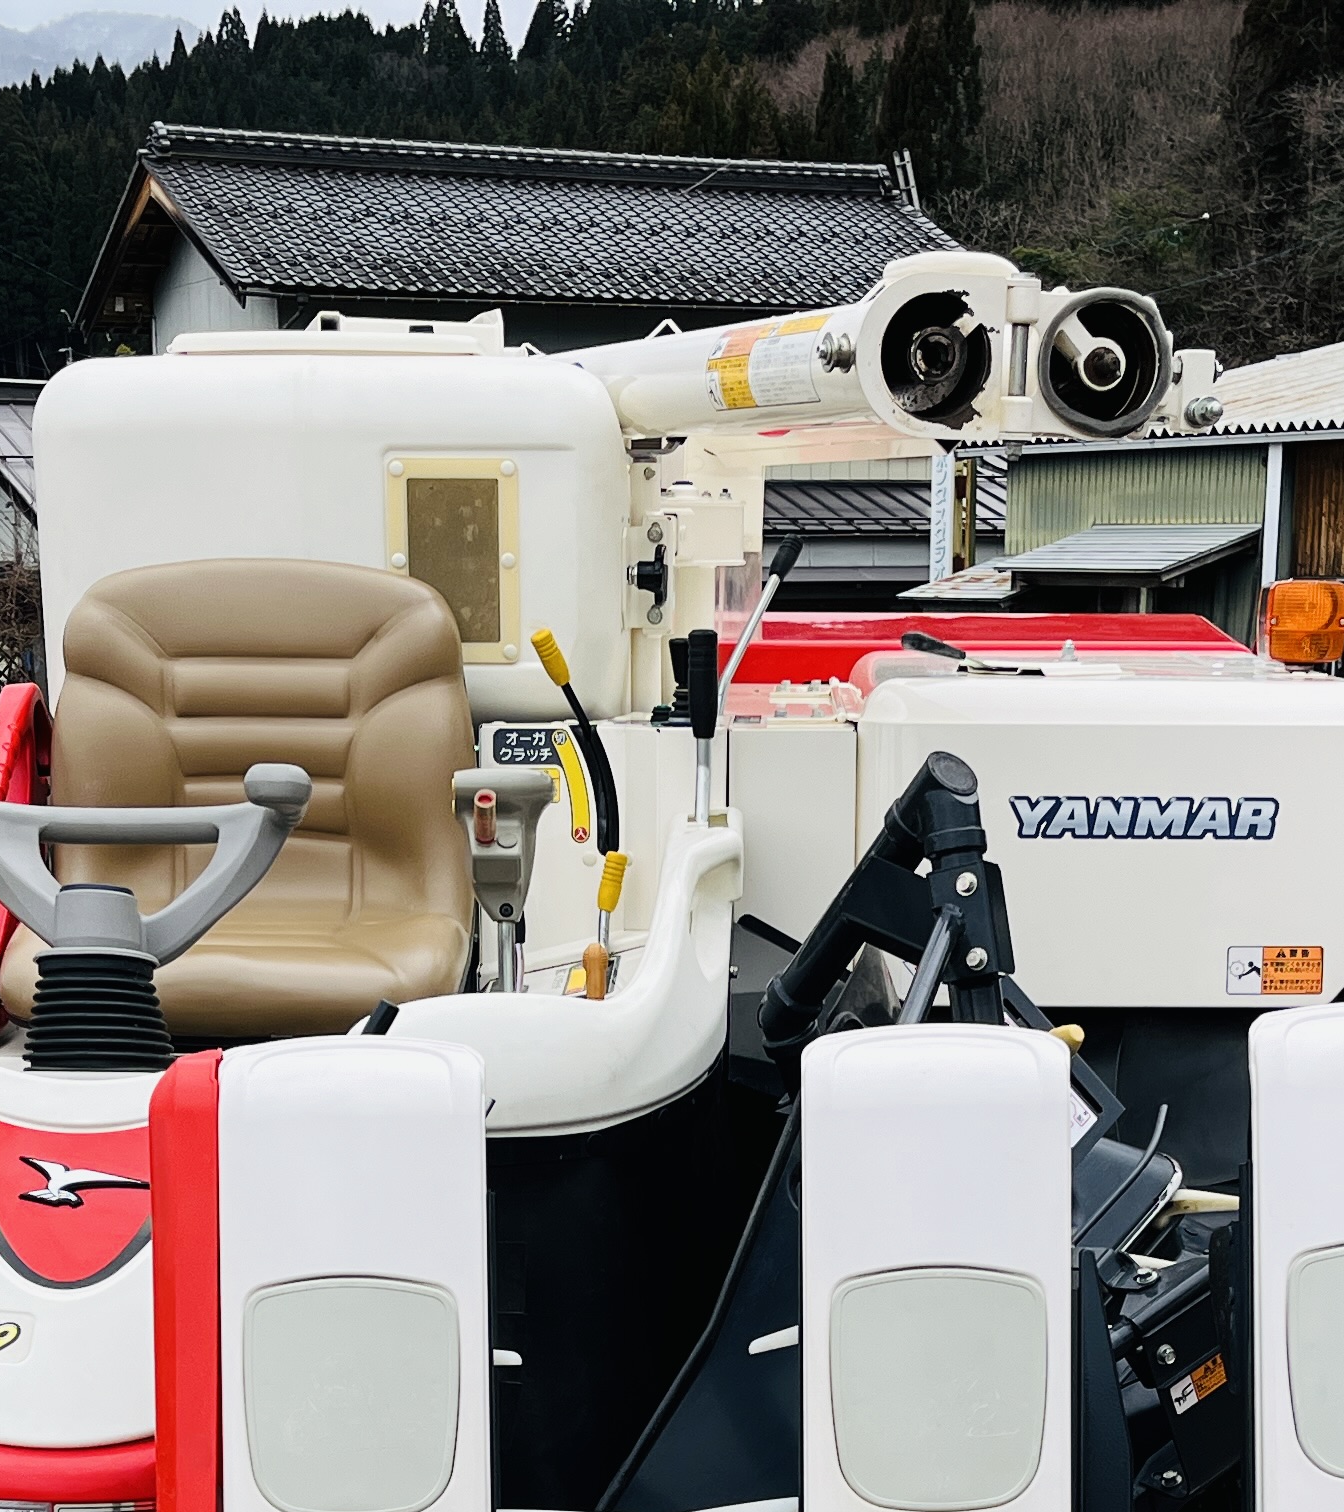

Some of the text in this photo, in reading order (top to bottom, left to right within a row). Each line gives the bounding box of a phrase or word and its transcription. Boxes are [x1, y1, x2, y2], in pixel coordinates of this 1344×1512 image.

[505, 731, 547, 746] オーガ
[499, 747, 553, 762] クラッチ
[1008, 795, 1280, 840] YANMAR
